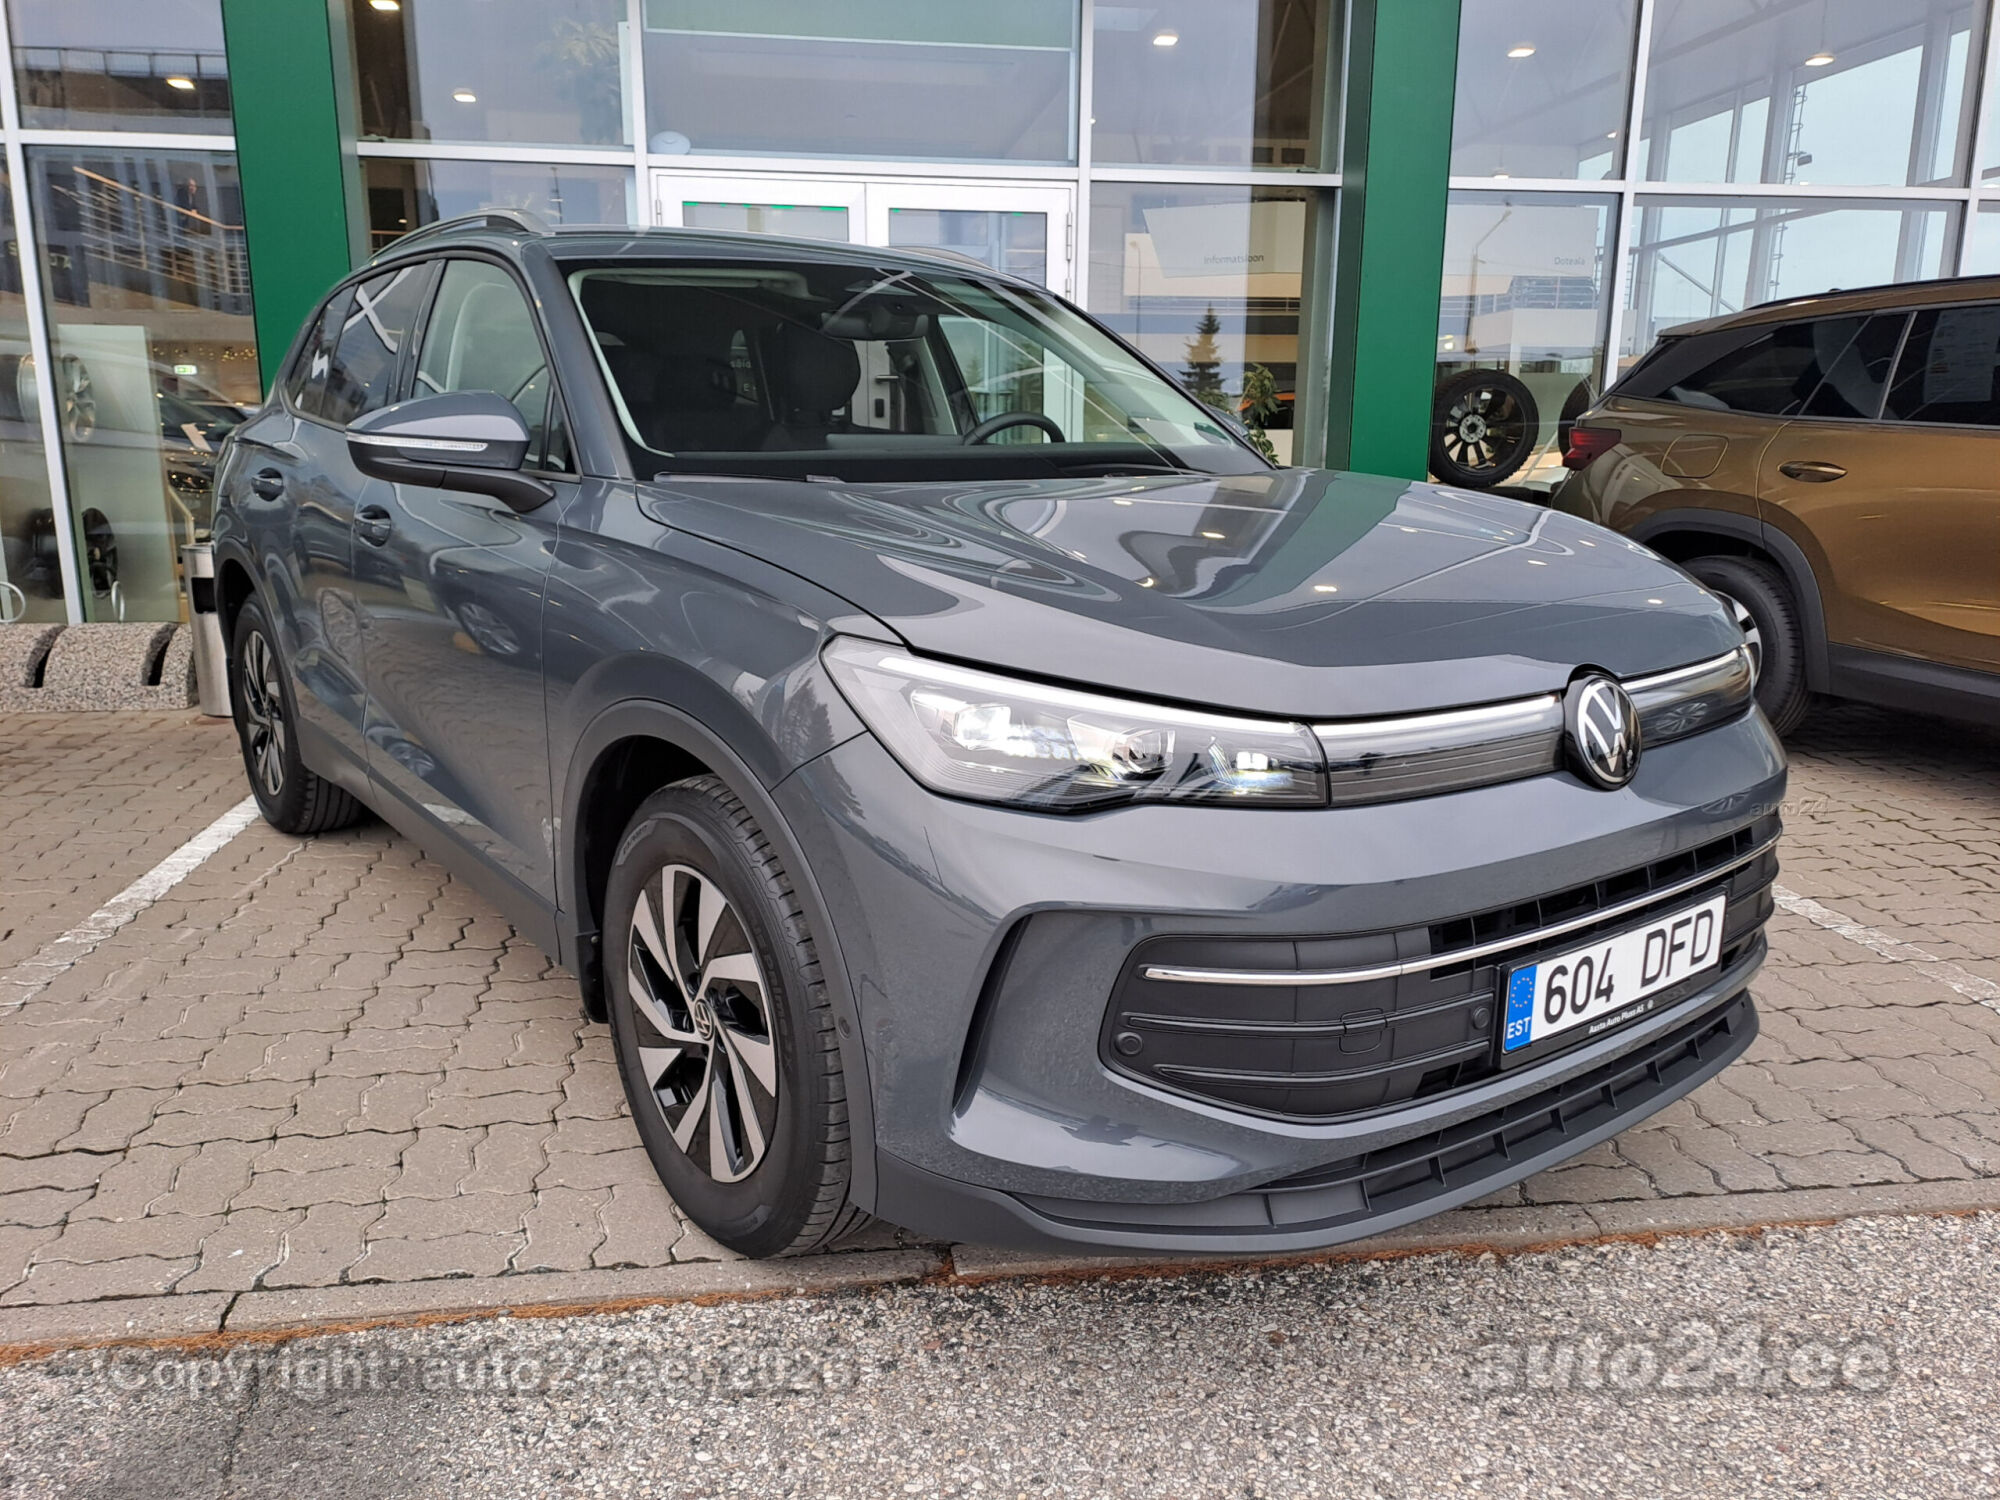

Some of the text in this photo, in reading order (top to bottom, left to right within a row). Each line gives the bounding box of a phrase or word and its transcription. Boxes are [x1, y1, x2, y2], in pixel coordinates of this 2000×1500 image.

[1544, 908, 1714, 1024] 604 DFD
[1506, 1016, 1532, 1040] EST
[1607, 1016, 1620, 1027] Auto
